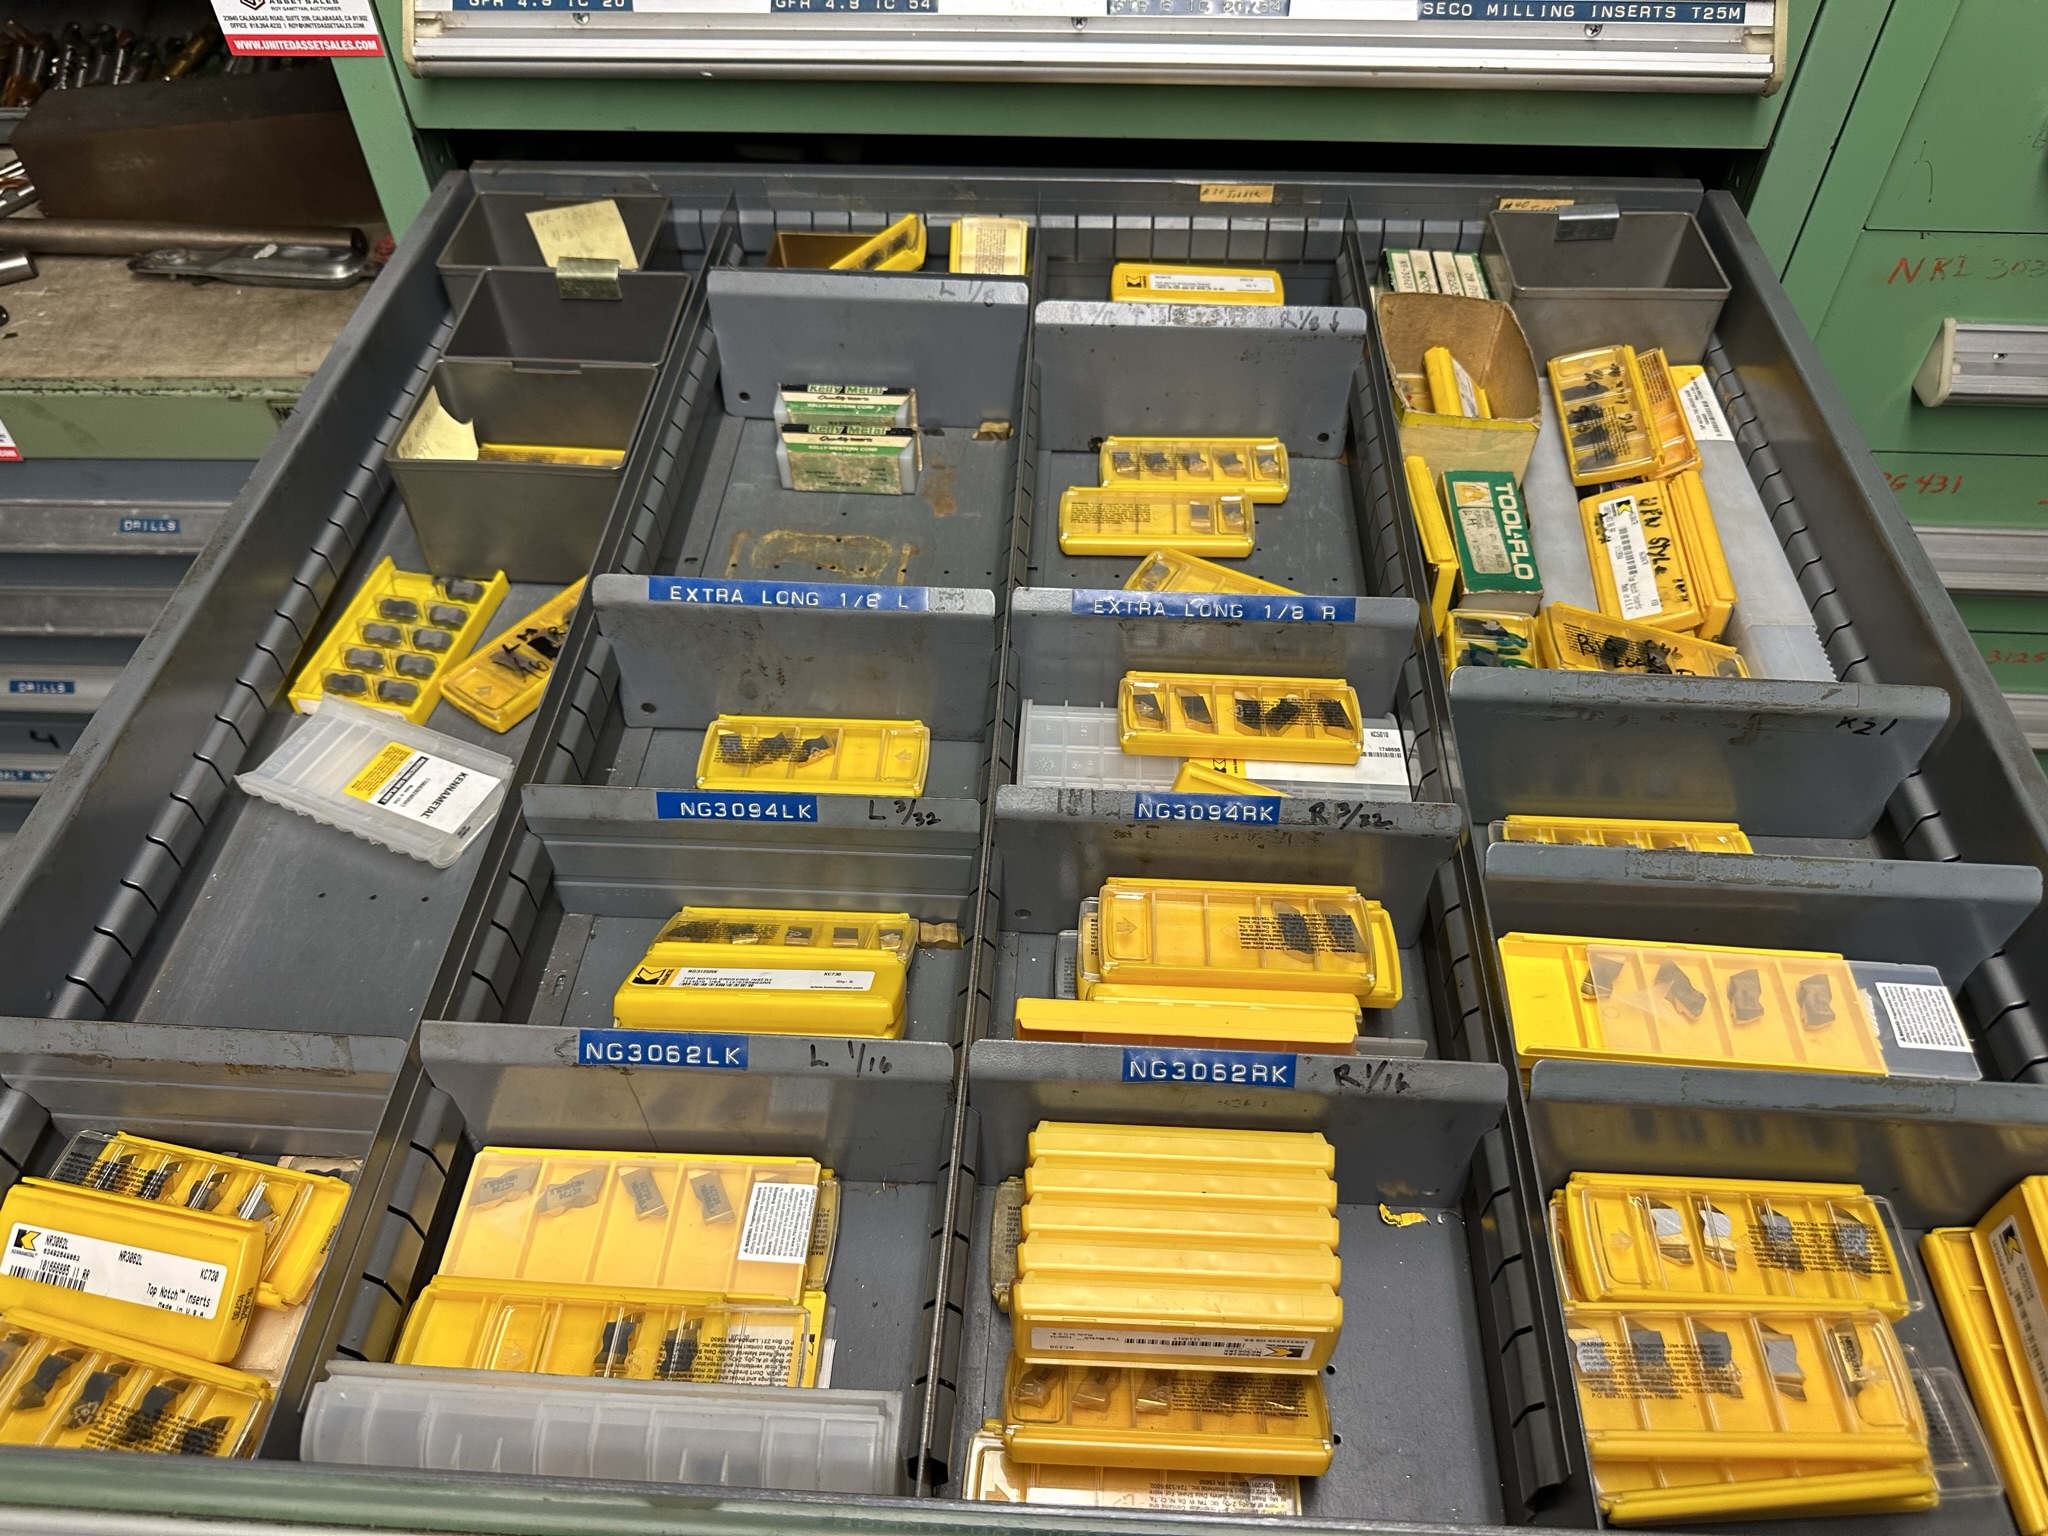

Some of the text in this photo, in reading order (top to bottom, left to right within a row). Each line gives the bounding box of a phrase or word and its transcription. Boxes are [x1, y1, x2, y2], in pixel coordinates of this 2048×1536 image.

[1422, 2, 1741, 20] SECO MILLING INSERTS T25M
[233, 39, 378, 51] WWW.UNITEDASSETSALES.COM
[807, 384, 885, 395] Kelly Metal
[808, 425, 888, 436] Kelly Metal
[124, 520, 176, 531] DRILLS
[670, 586, 909, 608] EXTRA LONG 1/8 L
[1094, 600, 1336, 620] EXTRA LONG 1/8 R
[420, 772, 469, 819] KENNAMETAL
[681, 802, 811, 819] NG3094LK
[868, 799, 941, 827] L 3/32
[1138, 803, 1273, 821] NG3094RK
[1309, 803, 1326, 824] R
[585, 1043, 740, 1064] NG3062LK
[810, 1040, 892, 1078] L 1/16
[1130, 1061, 1287, 1083] NG3062RK
[1334, 1060, 1411, 1093] R 1/16
[200, 1268, 220, 1282] KC730
[146, 1282, 157, 1297] Top
[186, 1292, 211, 1308] Inserts
[158, 1302, 173, 1311] Made
